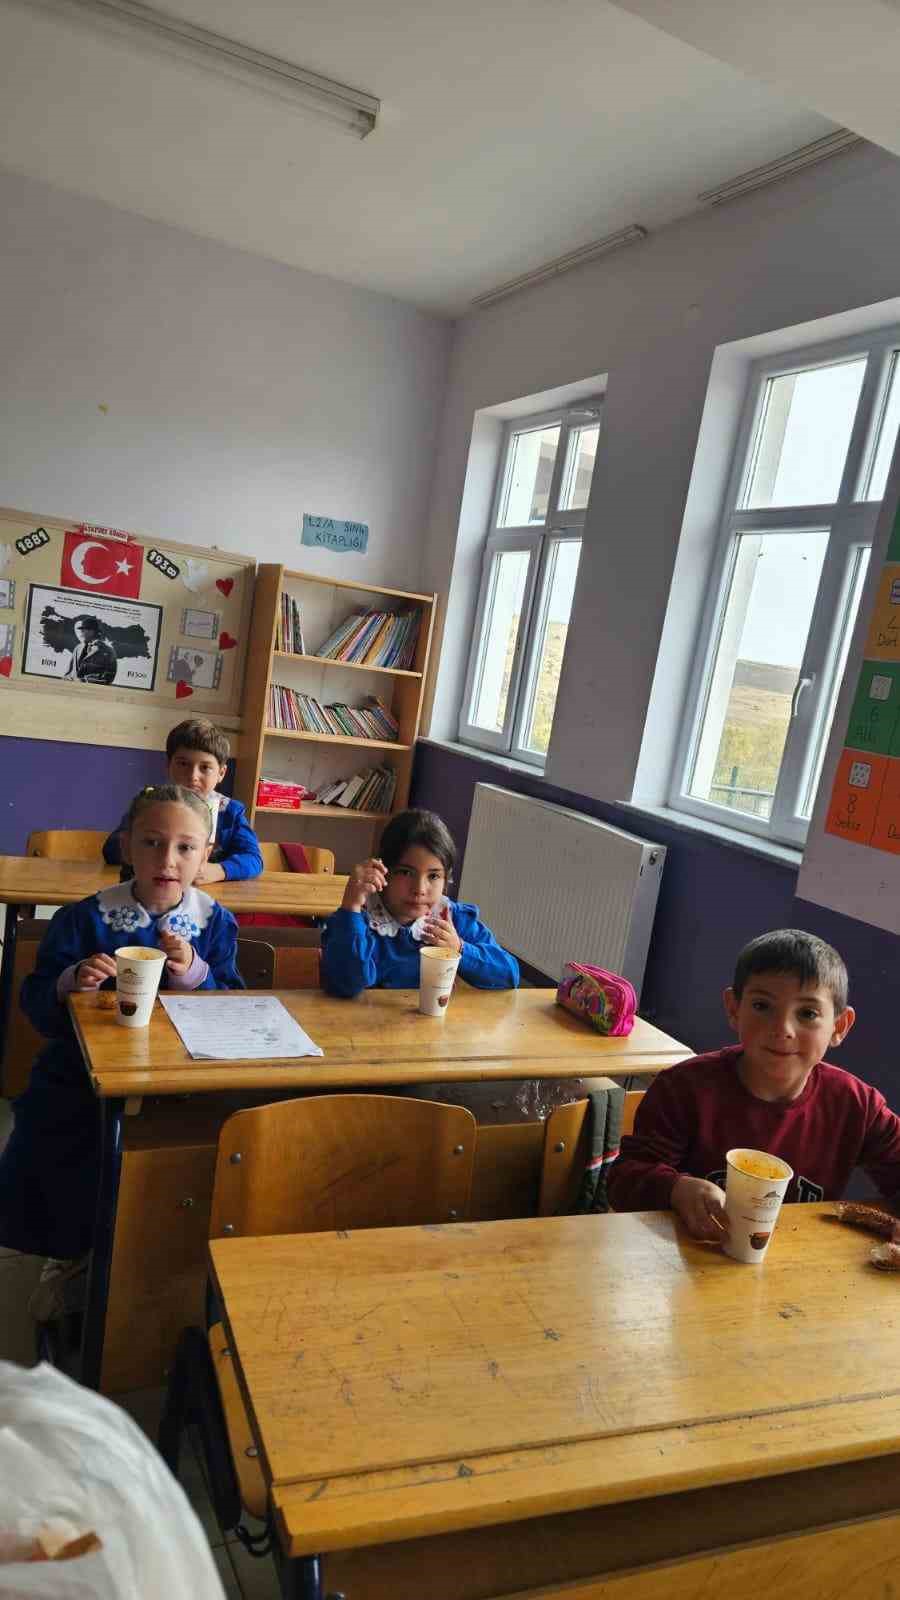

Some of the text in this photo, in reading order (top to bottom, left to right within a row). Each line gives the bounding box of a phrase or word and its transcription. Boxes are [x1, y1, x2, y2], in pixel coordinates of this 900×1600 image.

[17, 529, 48, 552] 1881
[149, 551, 177, 577] 1938
[847, 793, 858, 814] 8
